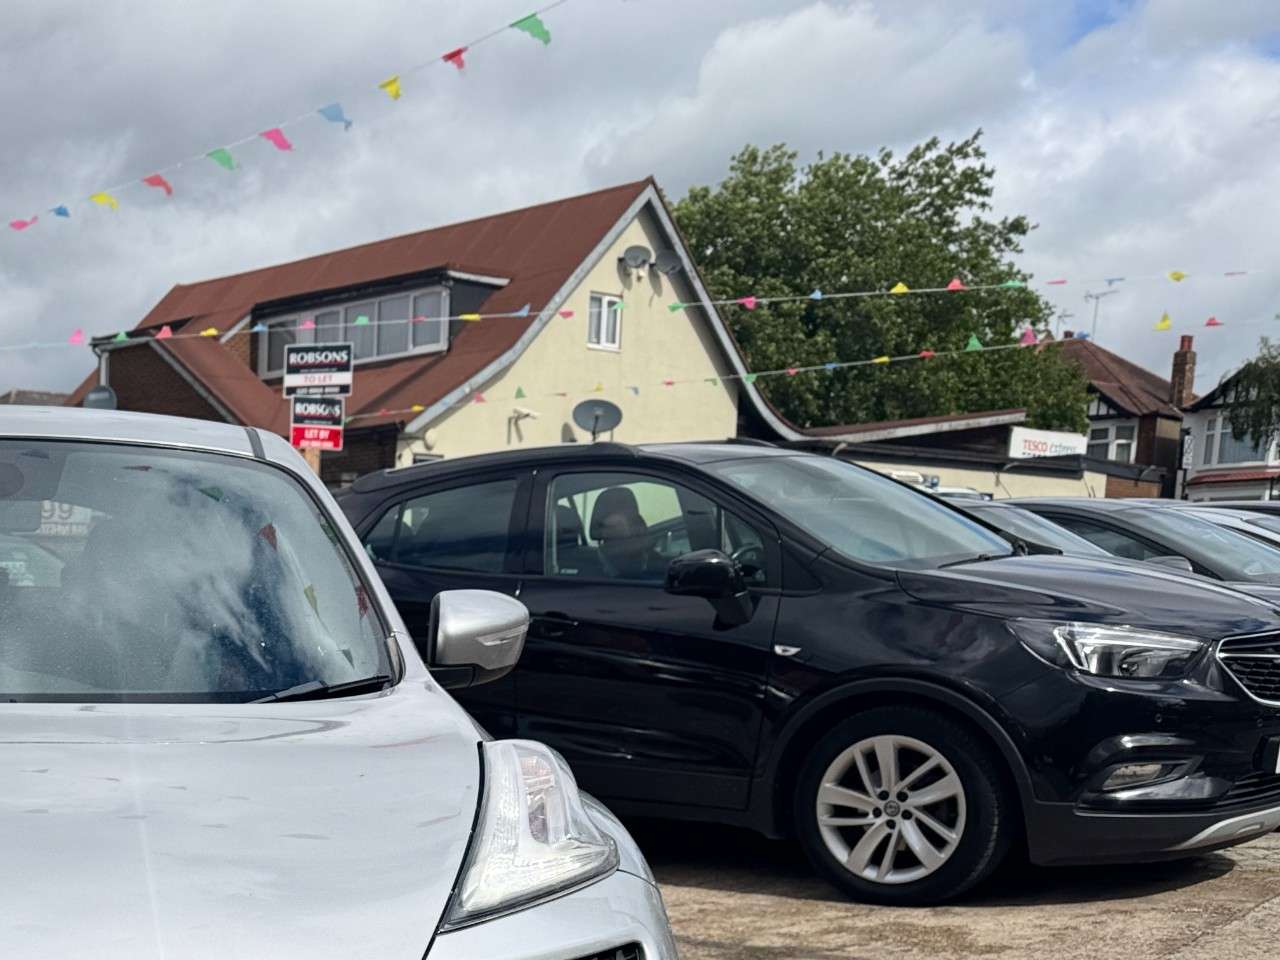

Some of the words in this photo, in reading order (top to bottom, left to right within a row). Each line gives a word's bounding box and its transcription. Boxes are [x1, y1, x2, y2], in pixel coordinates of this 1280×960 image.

[289, 350, 348, 365] ROBSONS
[304, 375, 316, 383] TO
[319, 375, 333, 383] LET
[304, 428, 318, 438] LET
[319, 429, 330, 439] BY
[1023, 438, 1048, 452] TESCO
